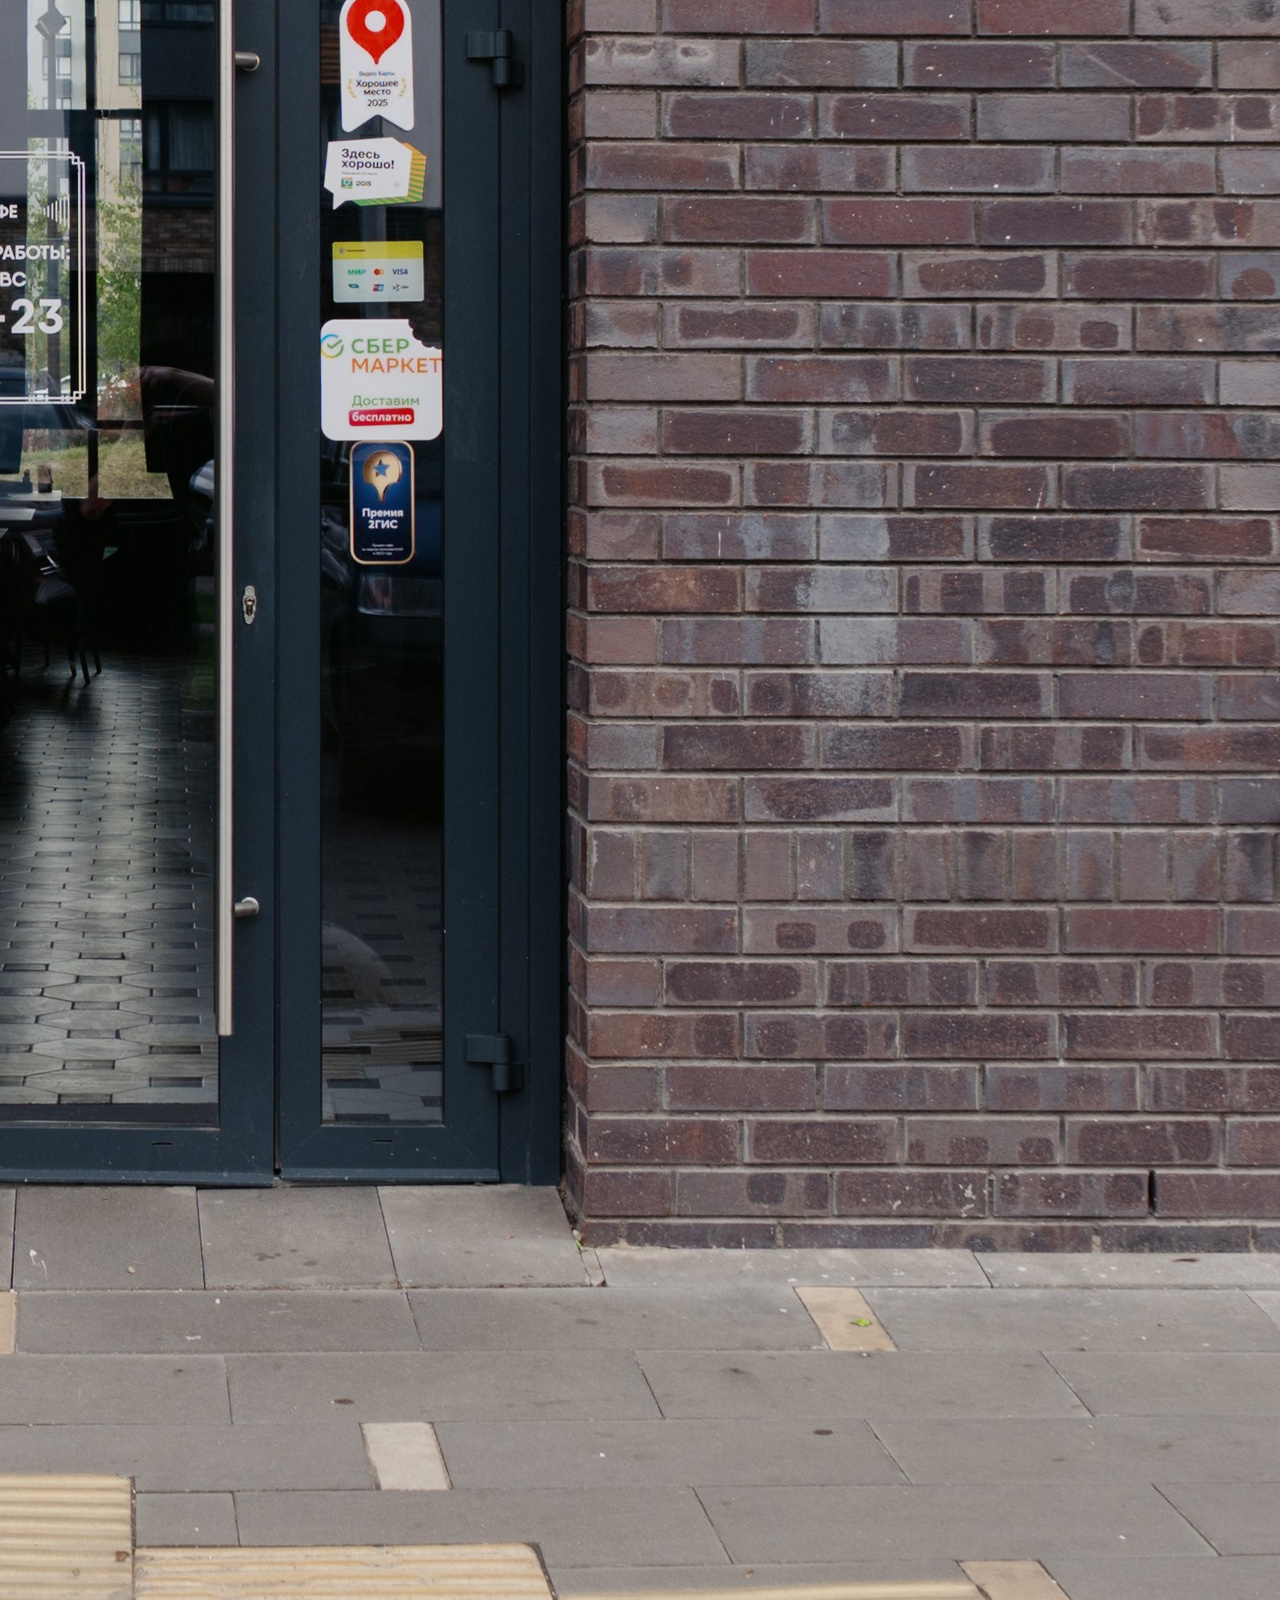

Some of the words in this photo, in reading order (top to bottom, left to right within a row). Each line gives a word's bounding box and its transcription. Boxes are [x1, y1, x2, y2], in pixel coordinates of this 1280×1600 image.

[356, 80, 399, 88] Хорошее
[367, 99, 388, 107] 2025
[341, 148, 380, 159] Здесь
[341, 160, 395, 170] хорошо!
[351, 338, 409, 354] СБЕР
[352, 358, 442, 373] МАРКЕТ
[352, 395, 420, 407] Доставим
[352, 411, 412, 422] бесплатно
[362, 508, 404, 519] Премия
[368, 520, 398, 529] 2ГИС
